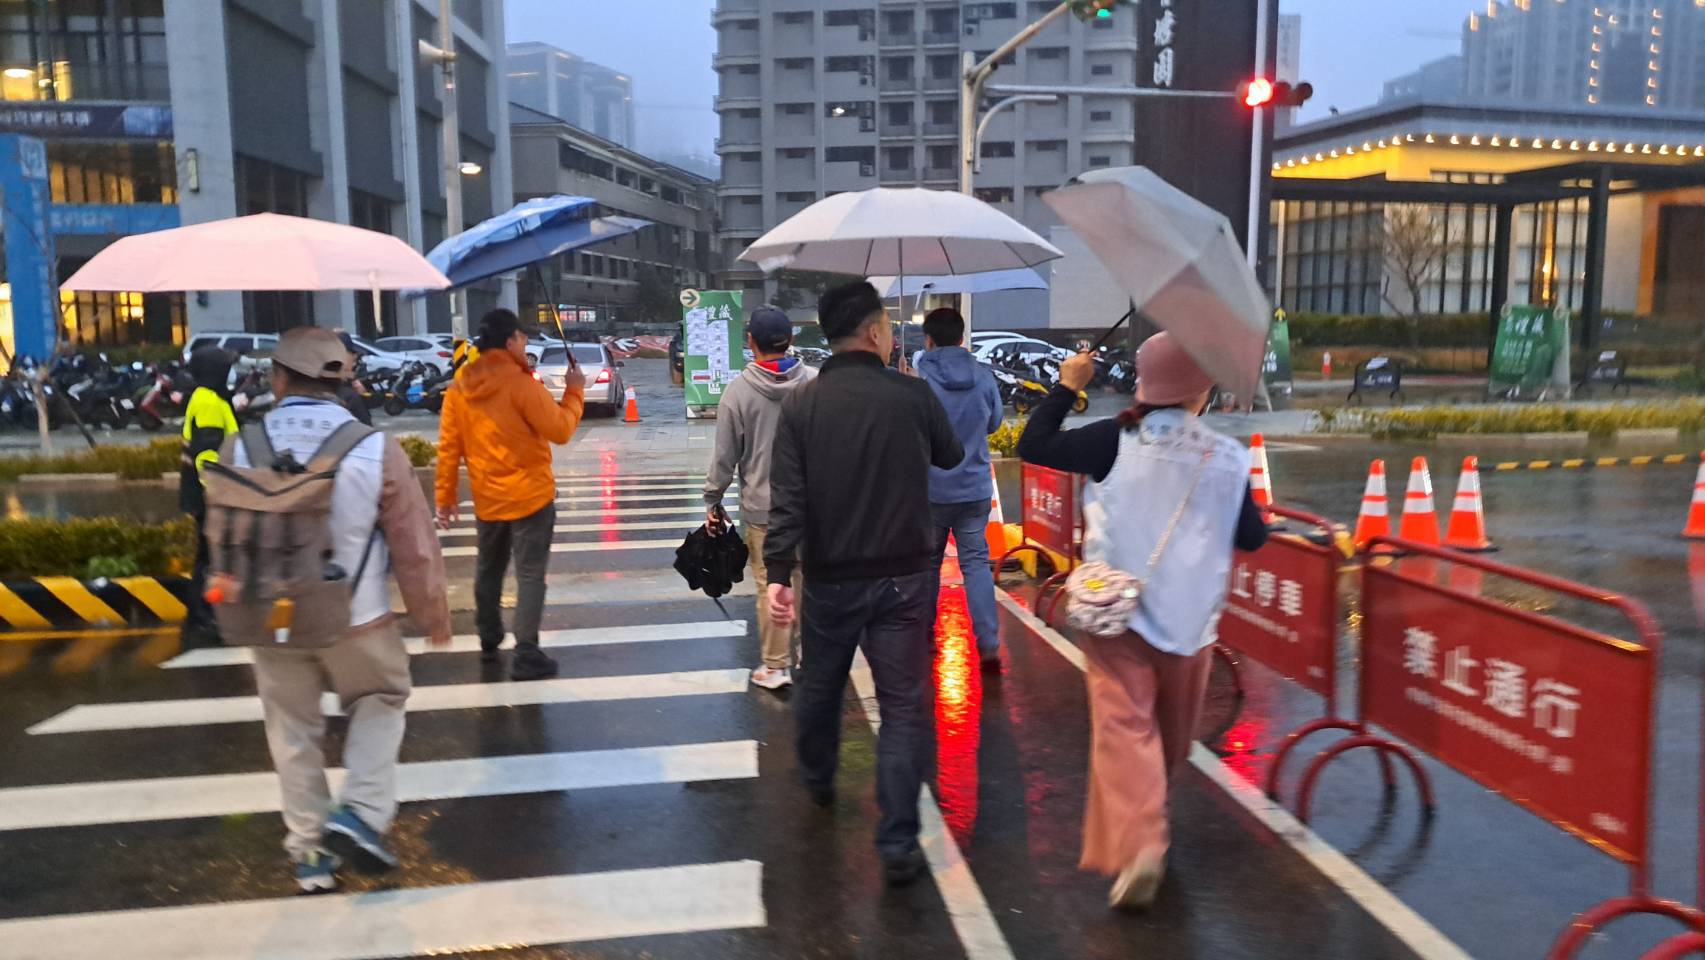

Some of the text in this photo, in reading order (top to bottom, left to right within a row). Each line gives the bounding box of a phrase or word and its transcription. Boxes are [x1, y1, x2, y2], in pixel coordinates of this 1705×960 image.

[1231, 562, 1304, 617] 止停車
[1403, 626, 1582, 738] 禁止通行
